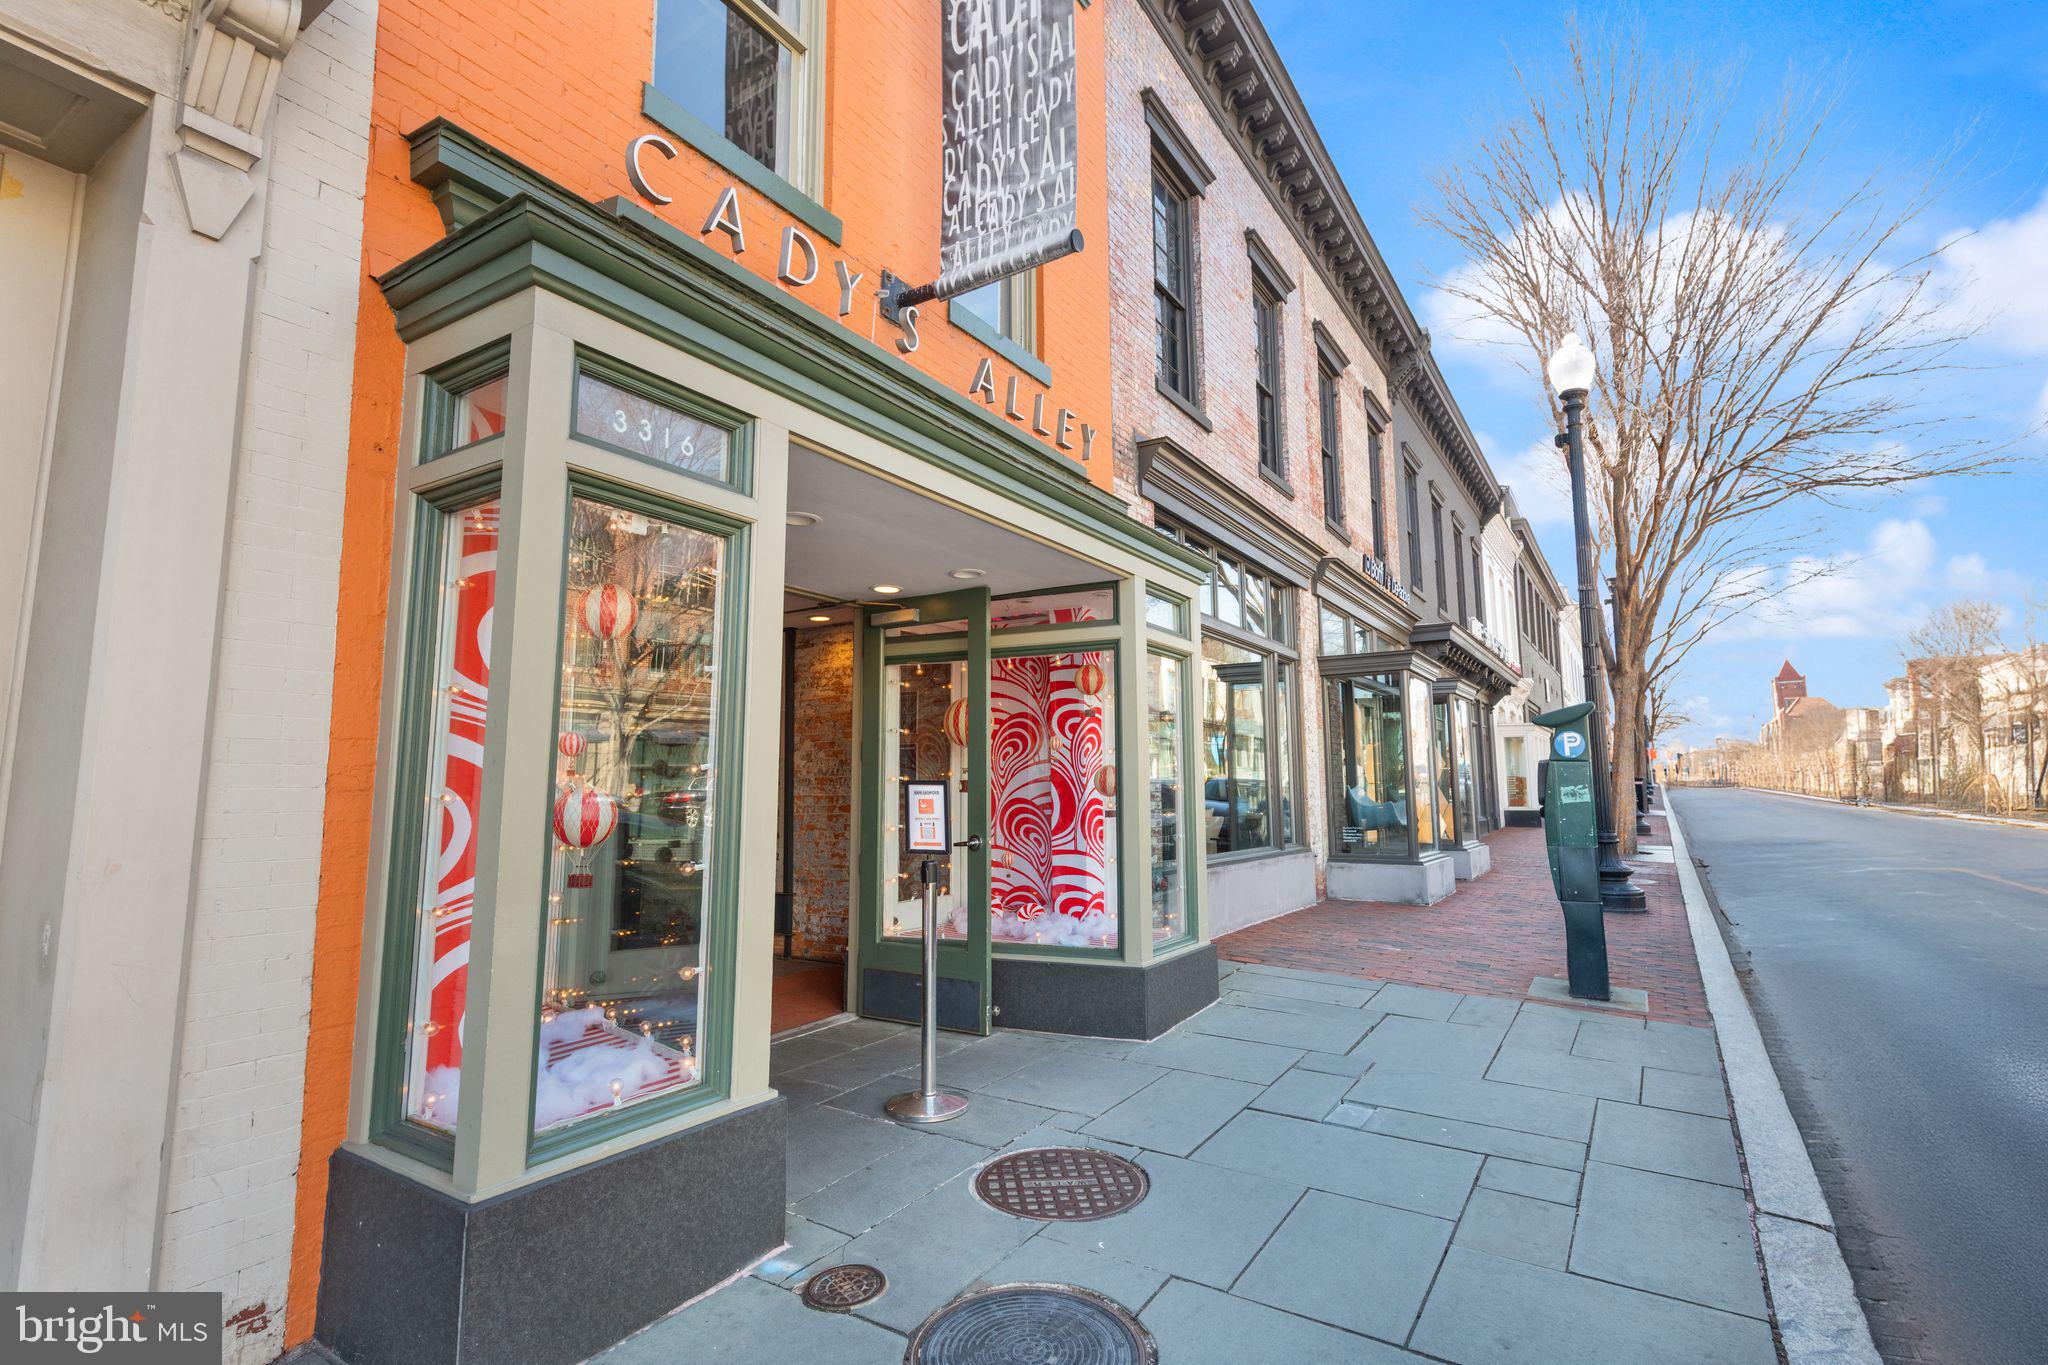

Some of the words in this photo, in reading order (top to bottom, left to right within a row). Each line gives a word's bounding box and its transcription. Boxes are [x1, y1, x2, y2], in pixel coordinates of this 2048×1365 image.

[952, 33, 1038, 111] CADY'S
[954, 84, 1014, 141] ALLEY
[1023, 68, 1074, 123] CADY
[992, 104, 1052, 160] ALLEY
[943, 149, 1030, 217] CADY'S
[612, 409, 694, 457] 3316
[969, 358, 1096, 461] ALLEY
[1563, 732, 1581, 756] P
